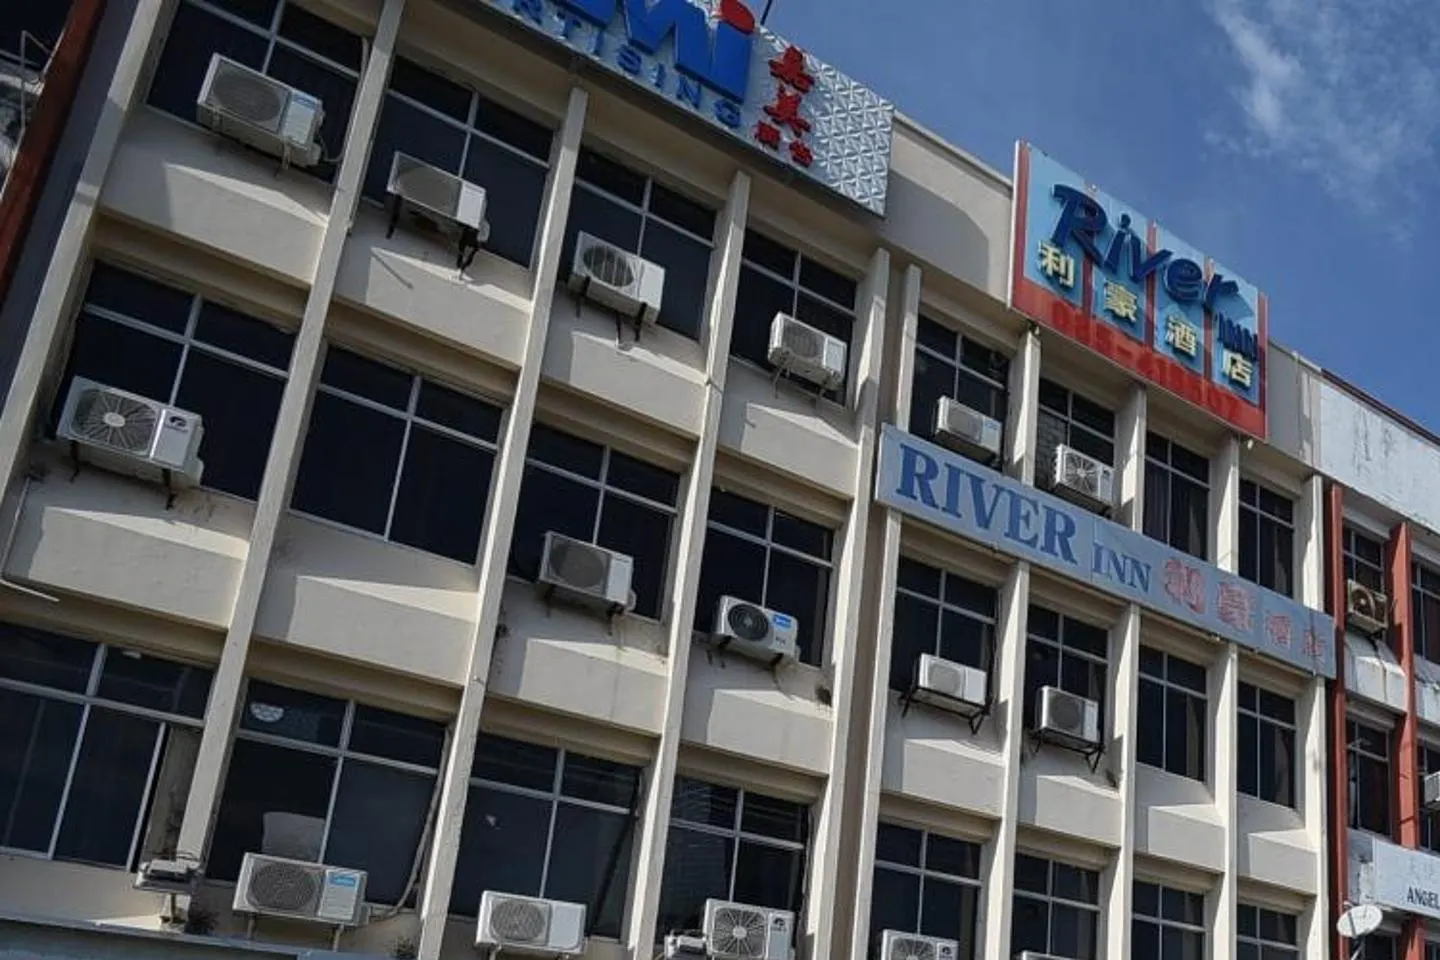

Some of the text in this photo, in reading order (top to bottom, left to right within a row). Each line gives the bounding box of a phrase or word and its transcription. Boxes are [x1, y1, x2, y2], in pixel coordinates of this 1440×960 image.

[1052, 183, 1240, 316] River
[895, 442, 1152, 595] RIVER INN
[1406, 886, 1440, 910] ANGEL
